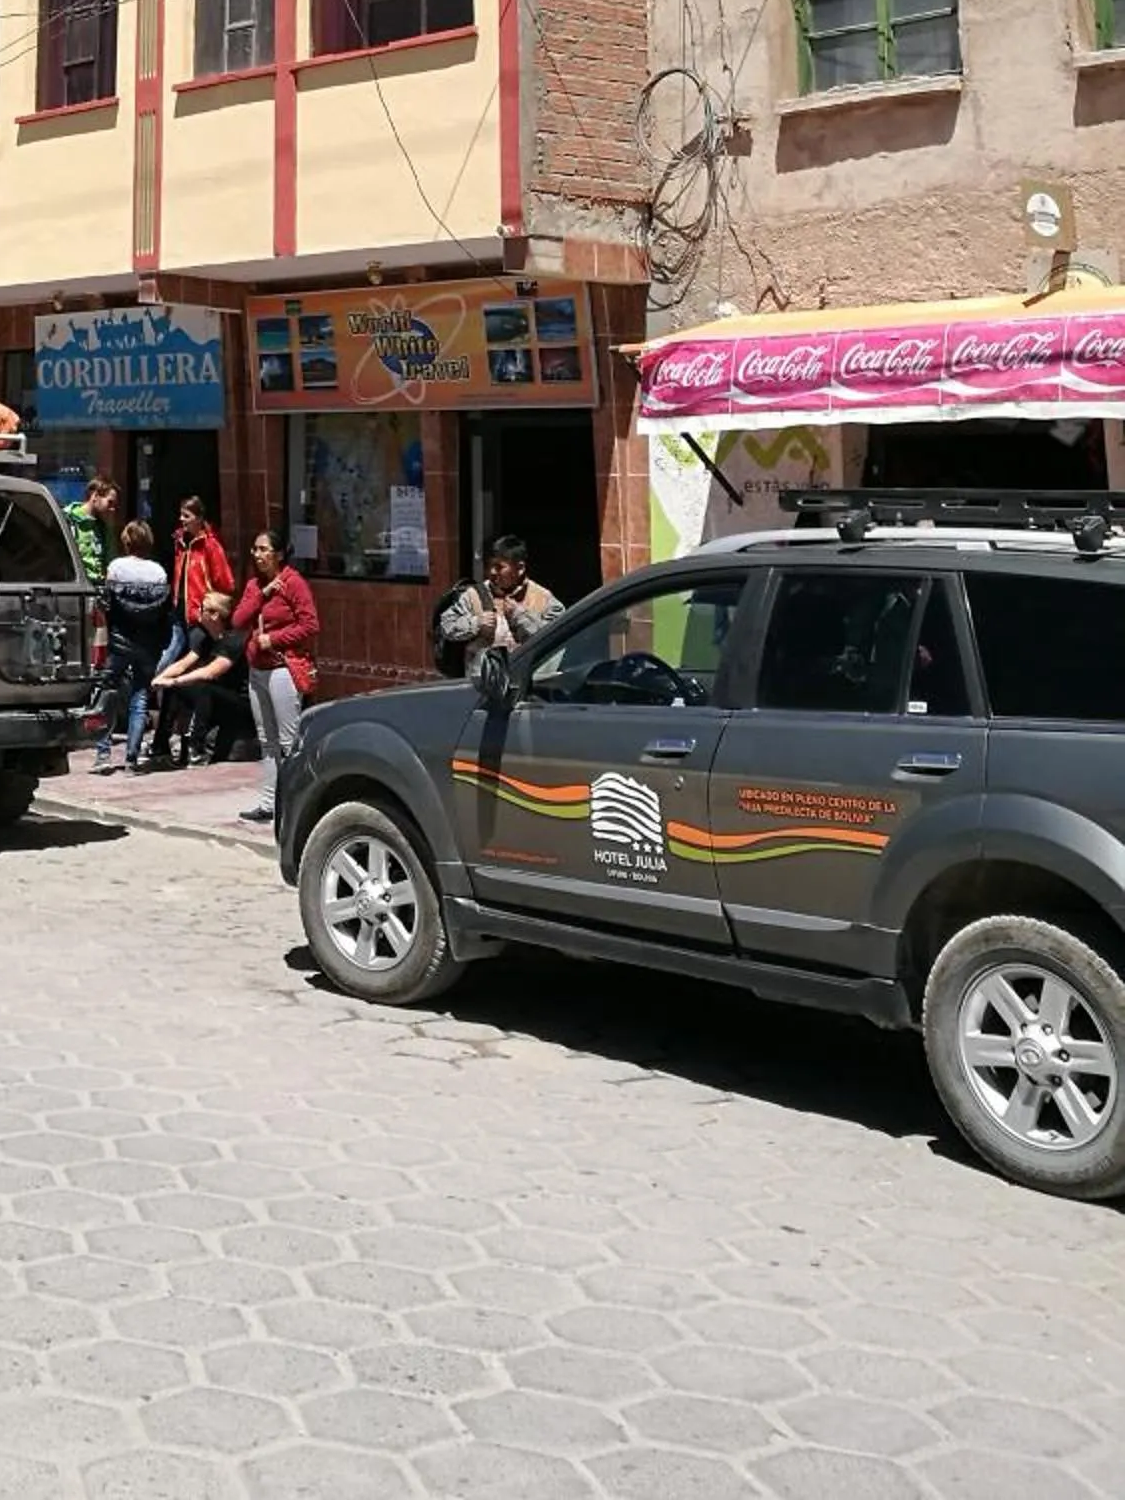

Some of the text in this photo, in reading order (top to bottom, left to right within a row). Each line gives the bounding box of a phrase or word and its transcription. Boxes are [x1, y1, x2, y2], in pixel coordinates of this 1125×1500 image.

[38, 352, 220, 389] CORDILLERA
[81, 389, 171, 415] Traveller
[884, 803, 896, 813] LA
[594, 848, 668, 873] HOTEL JULIA
